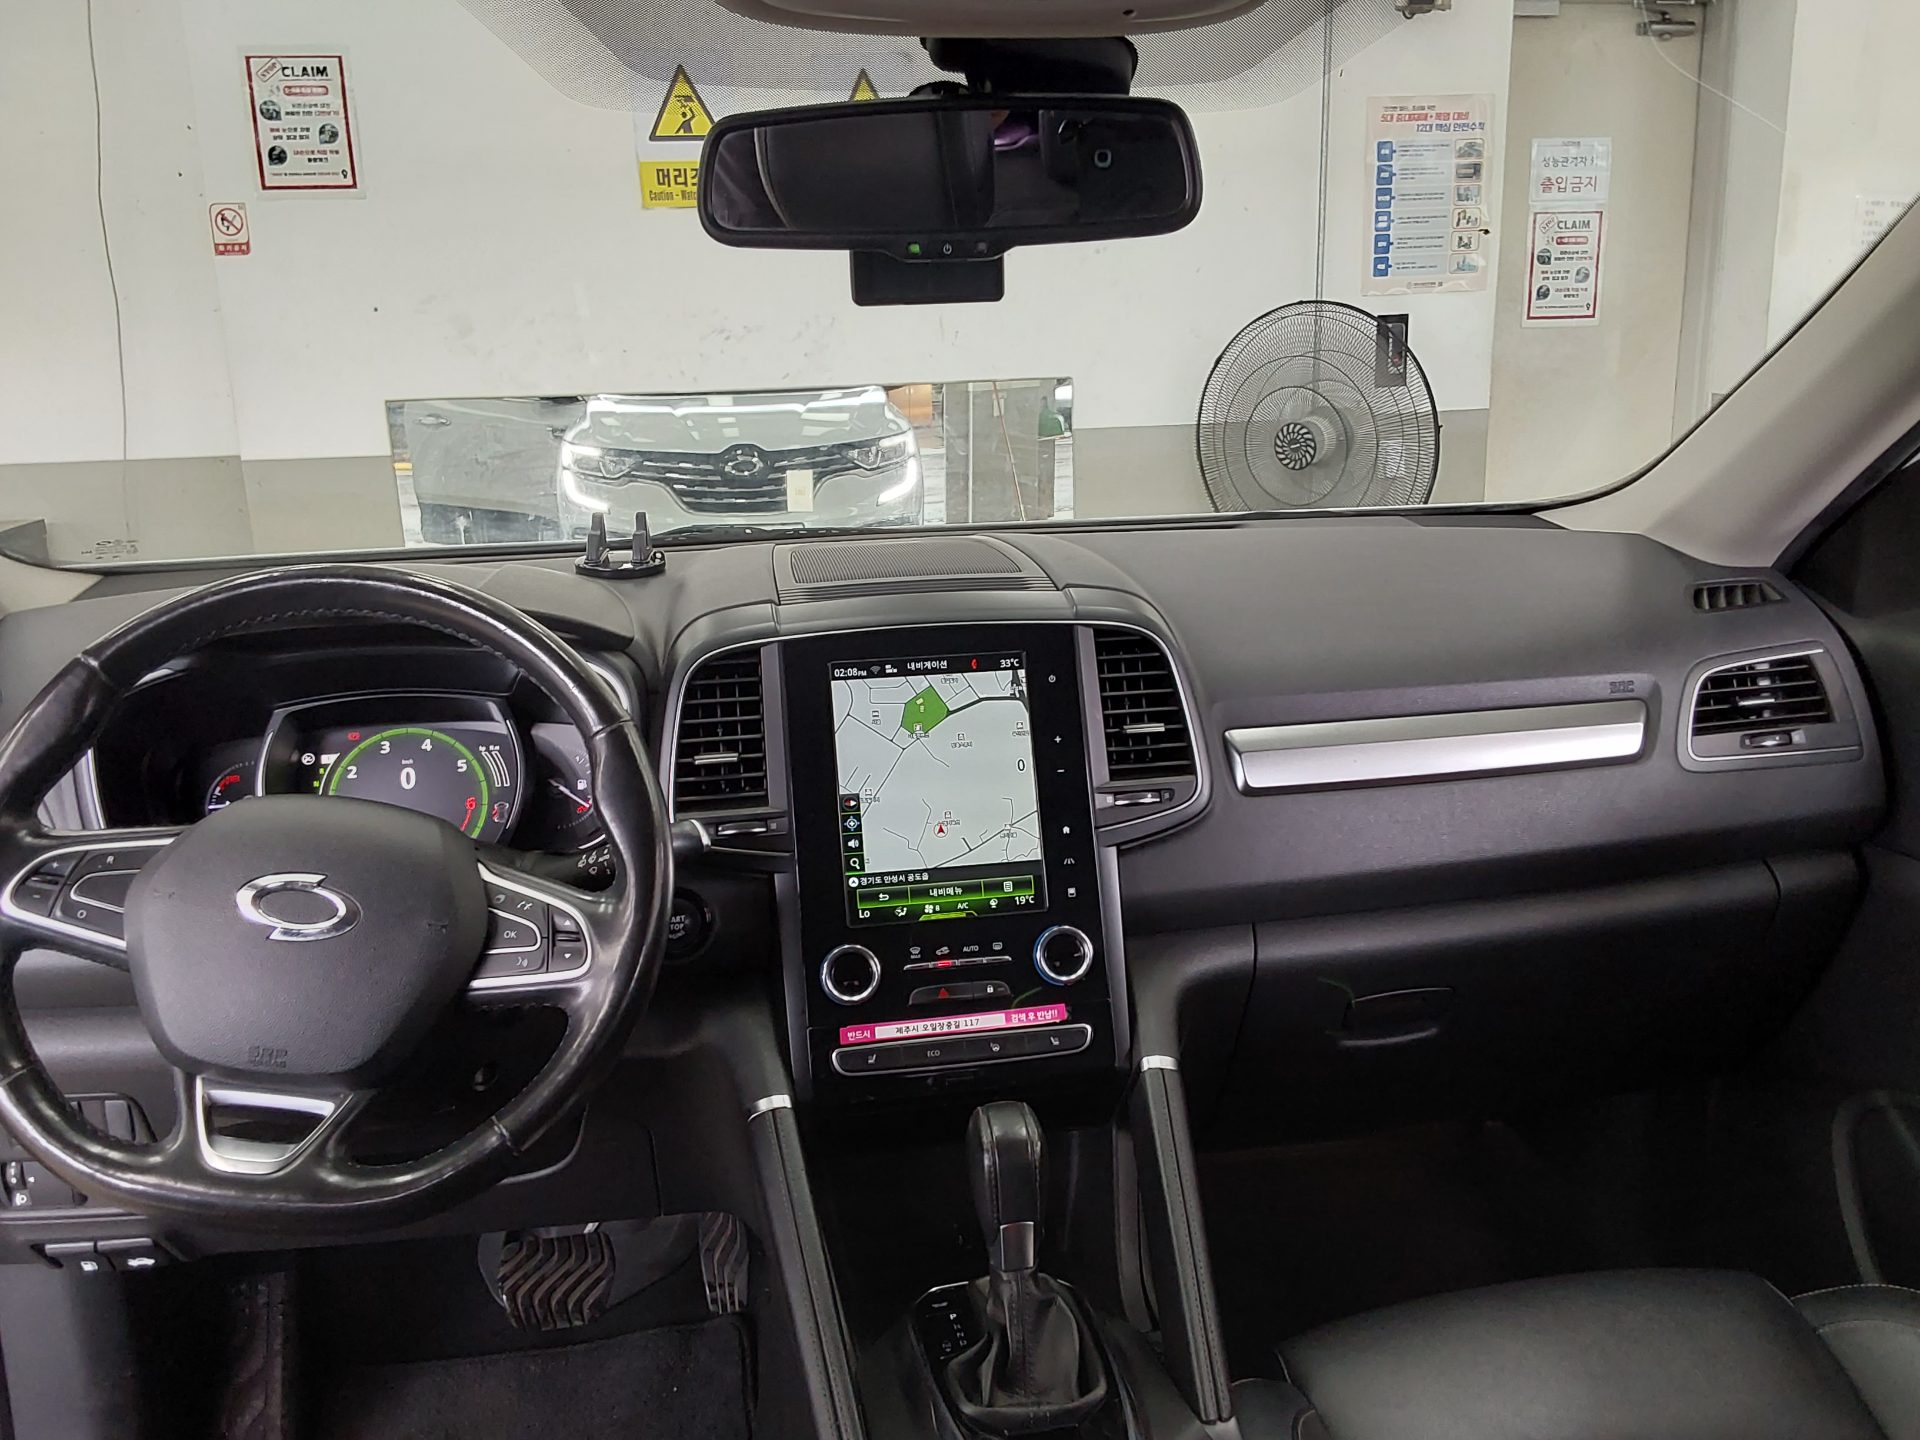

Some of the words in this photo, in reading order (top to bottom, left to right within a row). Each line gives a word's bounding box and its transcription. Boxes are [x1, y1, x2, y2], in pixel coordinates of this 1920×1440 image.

[281, 66, 329, 78] CLAIM
[1416, 123, 1433, 132] 12대
[656, 168, 698, 187] 머리조
[1540, 175, 1598, 194] 출입금지
[648, 189, 674, 202] Caution
[681, 189, 698, 201] Watc
[1557, 219, 1591, 230] CLAIM
[907, 659, 948, 671] 내비게이션
[380, 741, 391, 754] 3
[421, 739, 433, 752] 4
[457, 759, 468, 773] 5
[1017, 759, 1026, 772] 0
[346, 766, 358, 779] 2
[400, 767, 416, 790] 0
[465, 797, 477, 810] 6
[106, 855, 115, 865] R
[859, 876, 882, 886] 경기도
[883, 874, 906, 884] 안성시
[907, 872, 929, 882] 공도읍
[929, 886, 963, 897] 내비메뉴
[957, 902, 969, 910] A/C
[671, 915, 686, 923] ART
[858, 909, 871, 919] Lo
[503, 929, 517, 939] OK
[962, 945, 979, 953] AUTO
[847, 1029, 871, 1041] 반드시
[895, 1025, 919, 1035] 제주시
[964, 1018, 980, 1027] 117
[1011, 1012, 1027, 1023] 검색
[1028, 1012, 1036, 1021] 후
